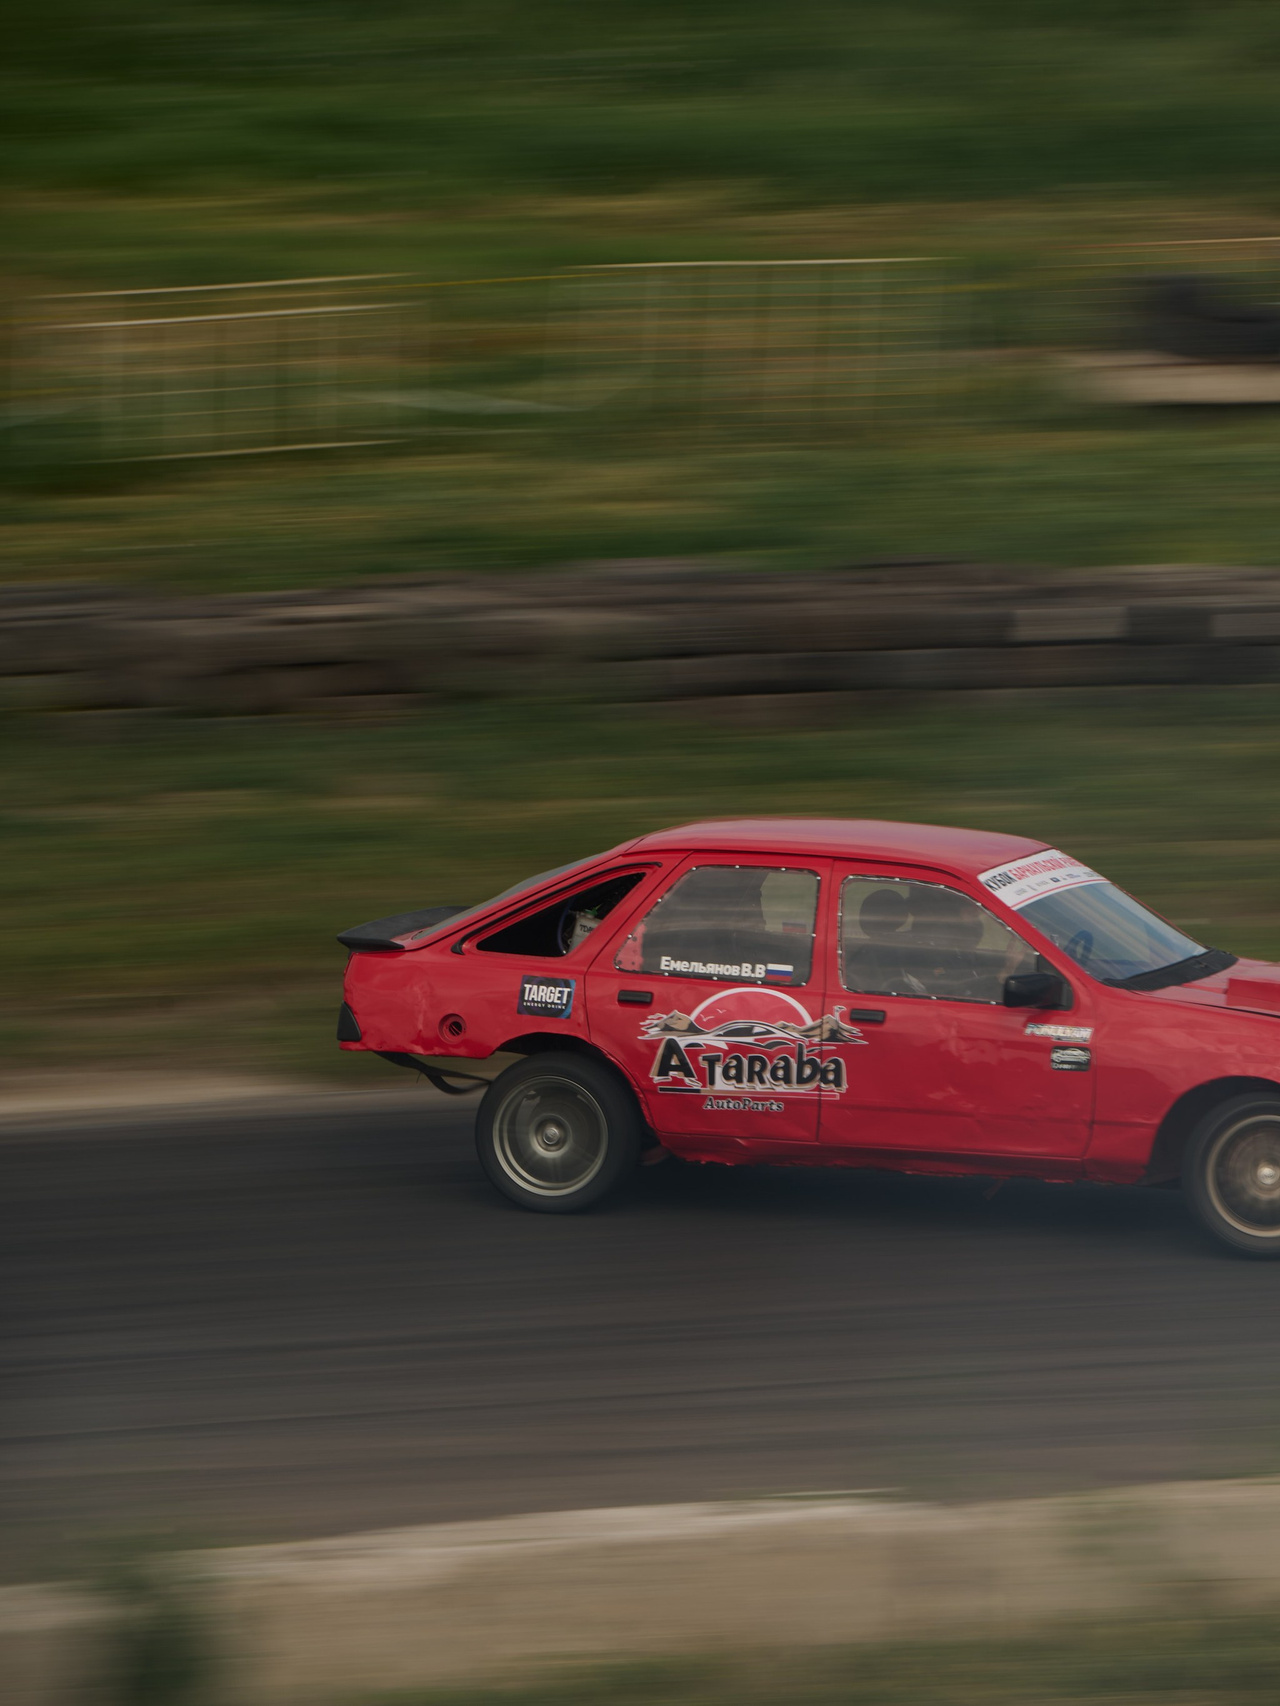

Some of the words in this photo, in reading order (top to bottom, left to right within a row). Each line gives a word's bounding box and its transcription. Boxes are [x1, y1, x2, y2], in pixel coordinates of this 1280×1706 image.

[984, 871, 1017, 892] КУБОК
[660, 956, 741, 976] Емельянов
[524, 984, 573, 1004] TARGET
[704, 1098, 784, 1112] AutoParts
